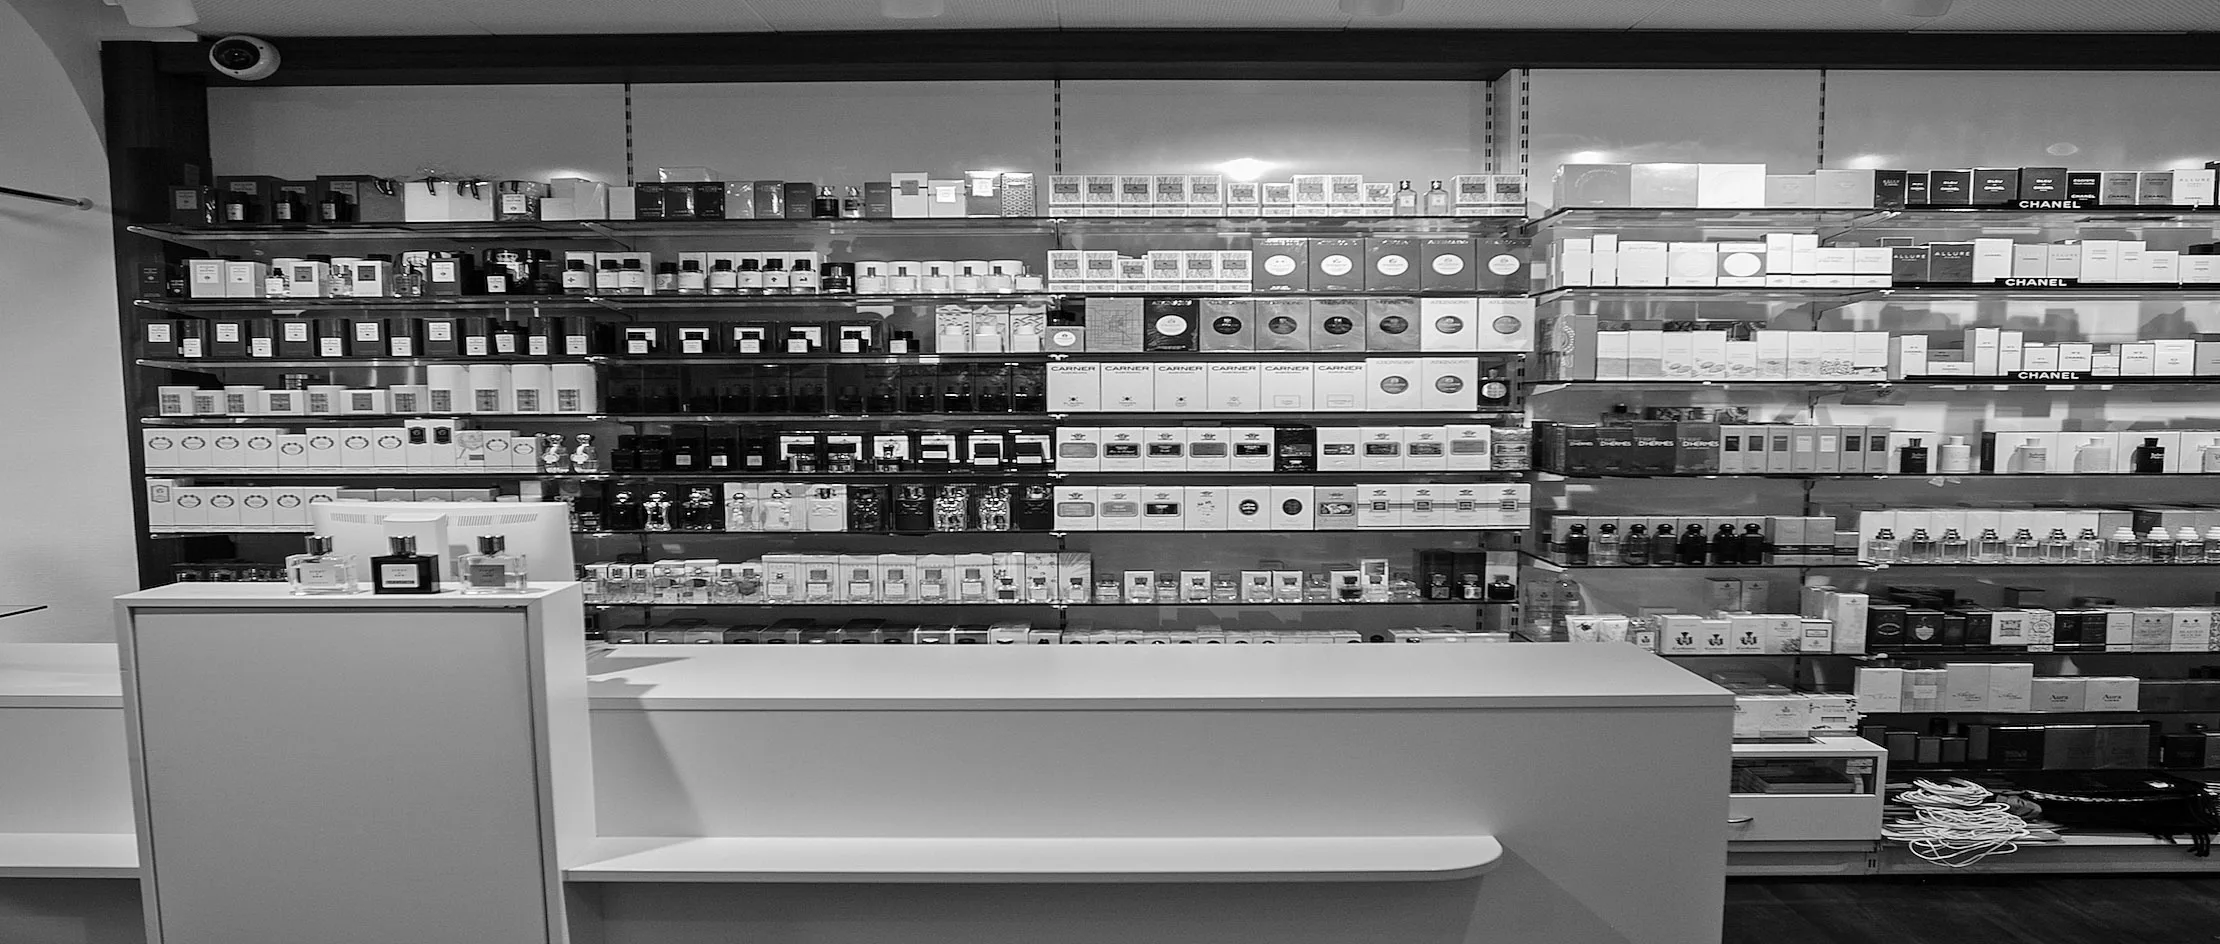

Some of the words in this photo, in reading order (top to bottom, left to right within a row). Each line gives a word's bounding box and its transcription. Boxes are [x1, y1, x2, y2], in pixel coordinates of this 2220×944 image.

[2019, 200, 2081, 209] CHANEL
[2005, 278, 2067, 287] CHANEL
[2018, 371, 2080, 380] CHANEL
